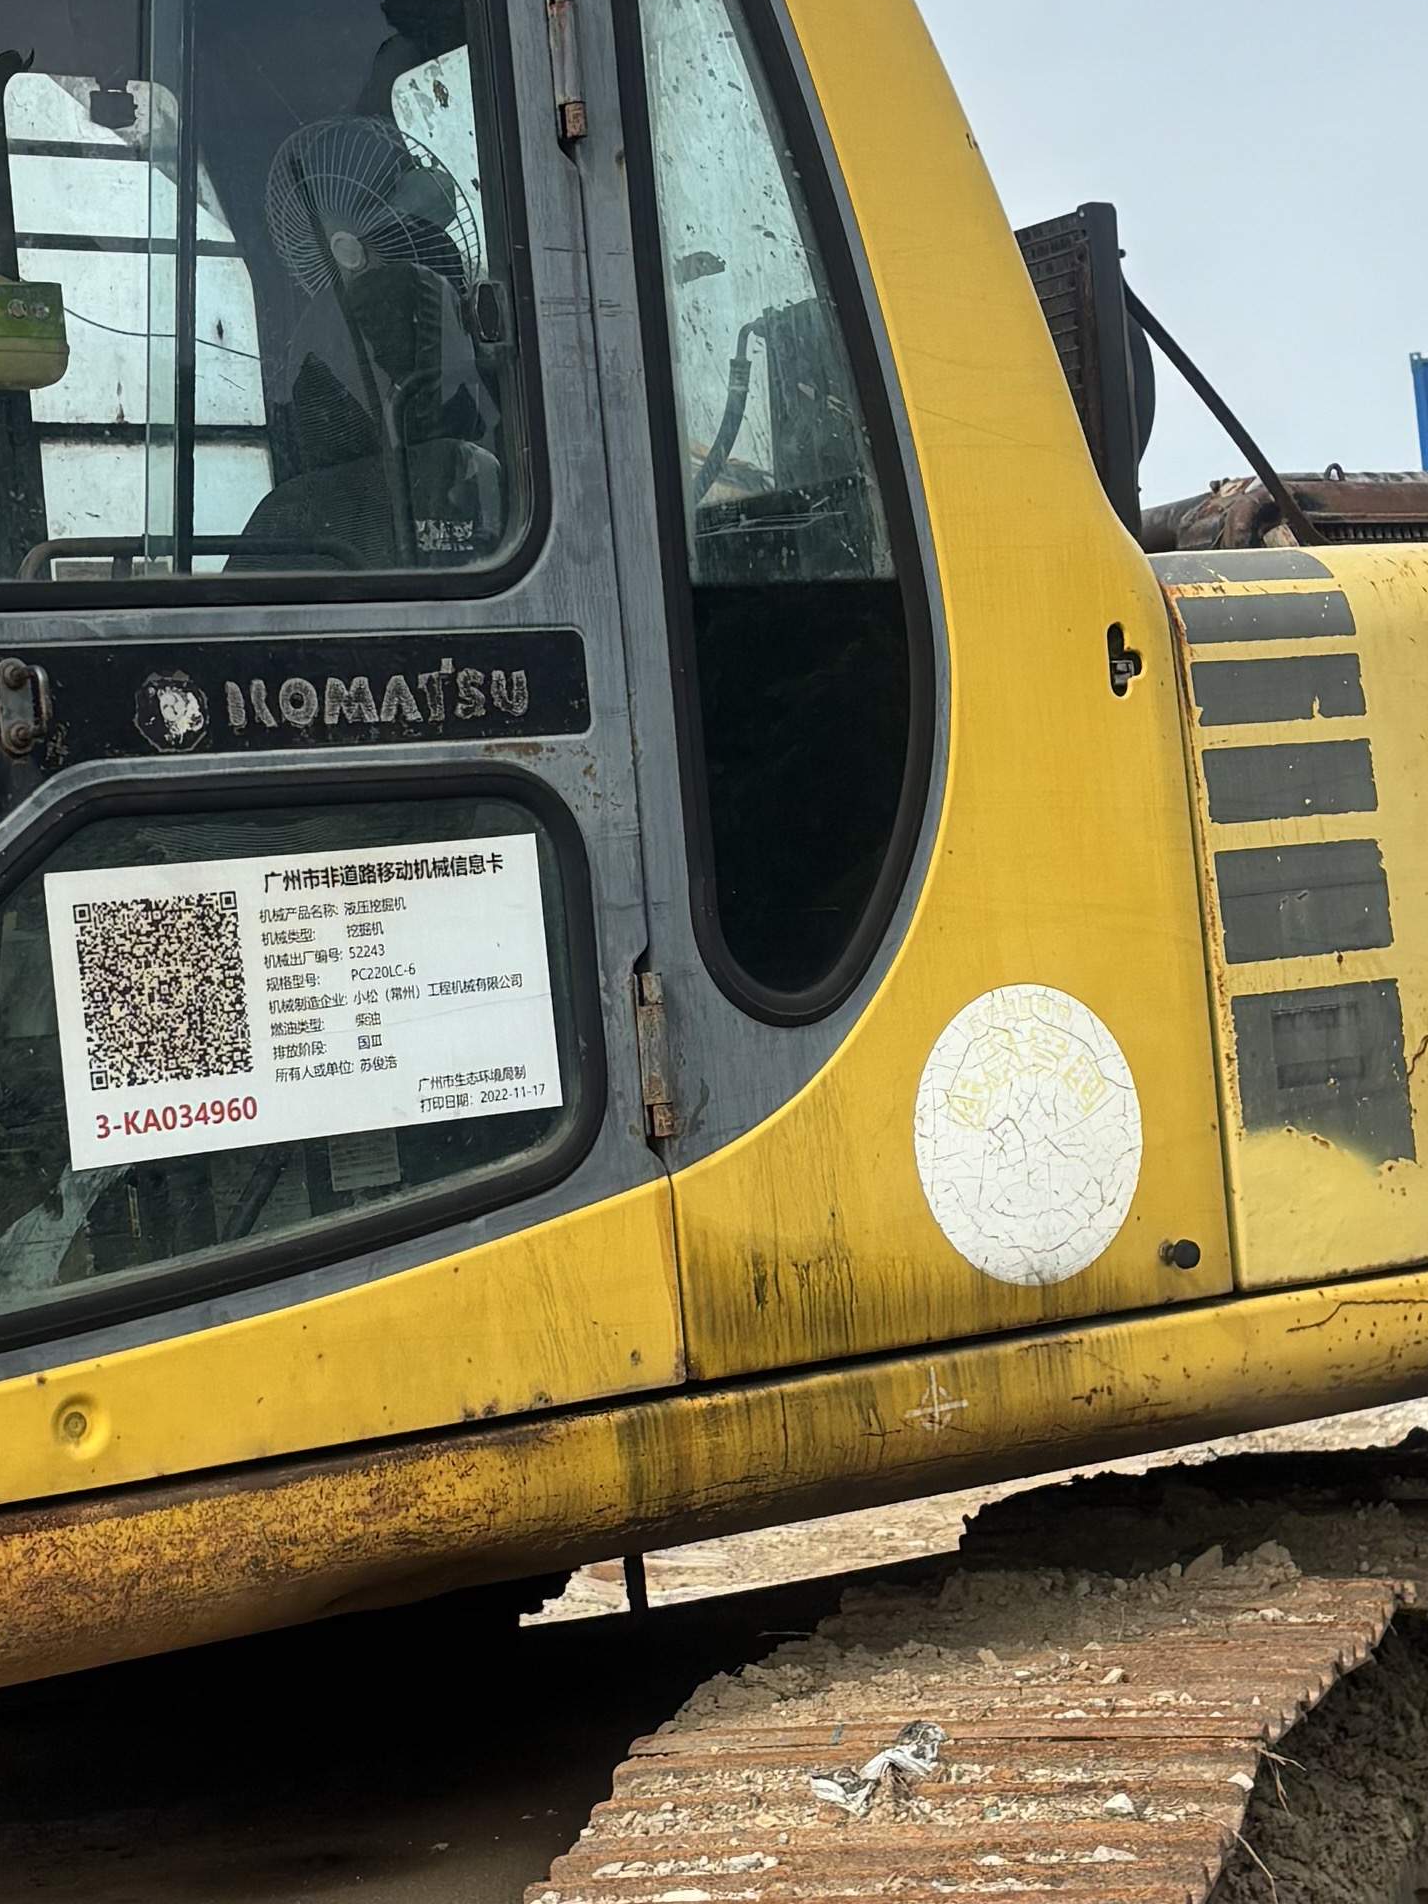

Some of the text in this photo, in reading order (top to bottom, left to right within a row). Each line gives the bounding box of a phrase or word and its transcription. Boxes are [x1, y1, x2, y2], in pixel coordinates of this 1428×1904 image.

[264, 852, 504, 893] 广州市非道路移动机械信息卡
[349, 944, 385, 960] 52243
[351, 964, 416, 982] PC220LC-6
[480, 1084, 546, 1104] 2022-11-17
[95, 1096, 258, 1140] 3-KA034960
